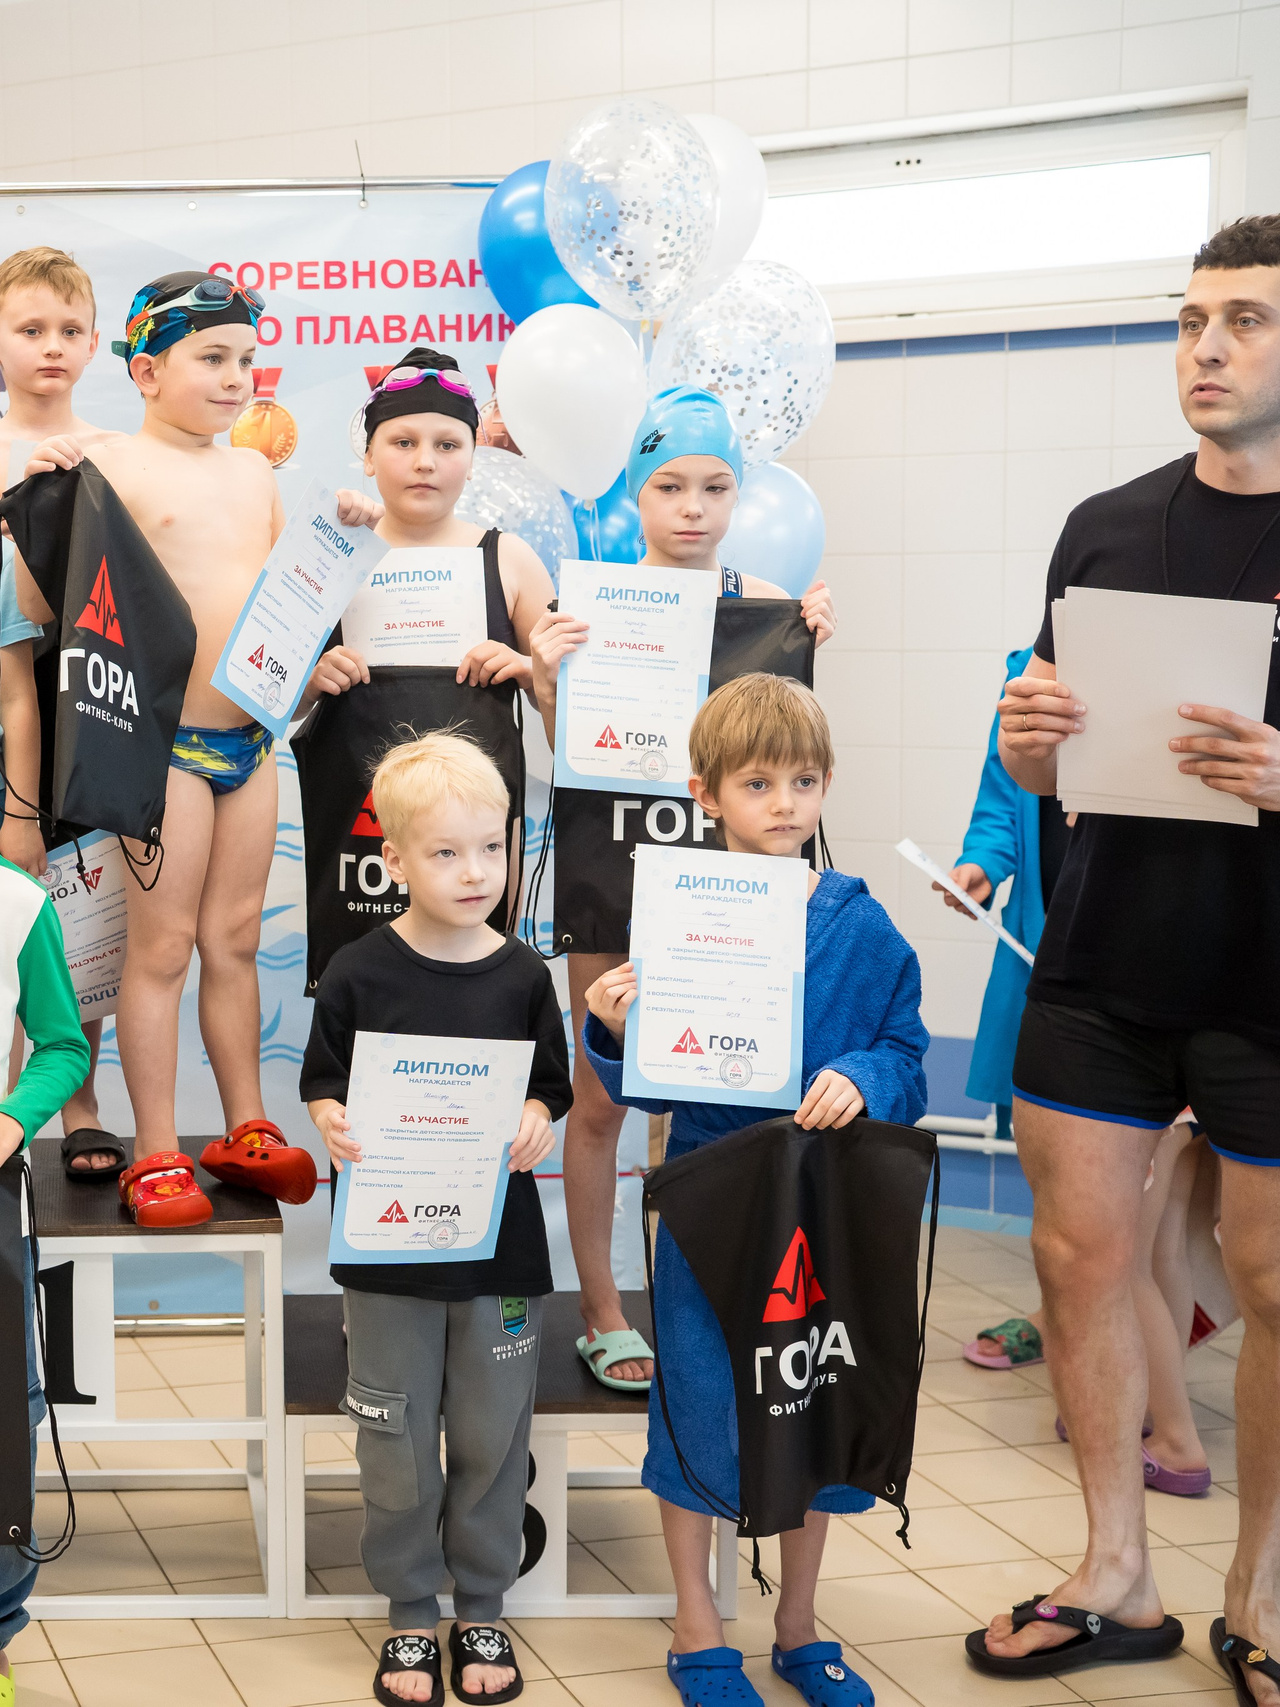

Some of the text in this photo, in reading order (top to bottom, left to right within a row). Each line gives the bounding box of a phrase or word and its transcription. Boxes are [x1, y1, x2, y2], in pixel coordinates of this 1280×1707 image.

[208, 259, 486, 290] СОРЕВНОВАН
[257, 316, 283, 346] О
[311, 514, 355, 557] ДИПЛОМ
[313, 534, 339, 559] НАГРАЖДАЕТСЯ
[293, 565, 302, 576] ЗА
[300, 571, 324, 595] УЧАСТИЕ
[371, 570, 452, 587] ДИПЛОМ
[726, 570, 737, 593] FILA
[596, 587, 680, 605] ДИПЛОМ
[610, 604, 665, 614] НАГРАЖДАЕТСЯ
[384, 620, 445, 630] ЗА УЧАСТИЕ
[603, 640, 665, 653] ЗА УЧАСТИЕ
[265, 656, 288, 683] ГОРА
[59, 648, 140, 717] ГОРА
[75, 701, 133, 733] ФИТНЕС-КЛУБ
[625, 732, 668, 748] ГОРА
[613, 800, 716, 842] ГОР
[338, 853, 408, 896] ГО
[50, 882, 78, 902] ГОР
[675, 874, 769, 895] ДИПЛОМ
[347, 901, 411, 914] ФИТНЕС-
[691, 894, 753, 904] НАГРАЖДАЕТСЯ
[685, 933, 755, 947] ЗА УЧАСТИЕ
[108, 946, 122, 958] ЗА
[76, 977, 122, 995] АГРАЖДАЕТСЯ
[709, 1035, 759, 1053] ГОРА
[392, 1060, 489, 1077] ДИПЛОМ
[408, 1078, 471, 1086] НАГРАЖДАЕТСЯ
[399, 1115, 469, 1124] ЗА УЧАСТИЕ
[414, 1205, 461, 1217] ГОРА
[38, 1260, 97, 1405] 1
[754, 1320, 857, 1394] ГОРА
[346, 1392, 389, 1421] MINECRAFT
